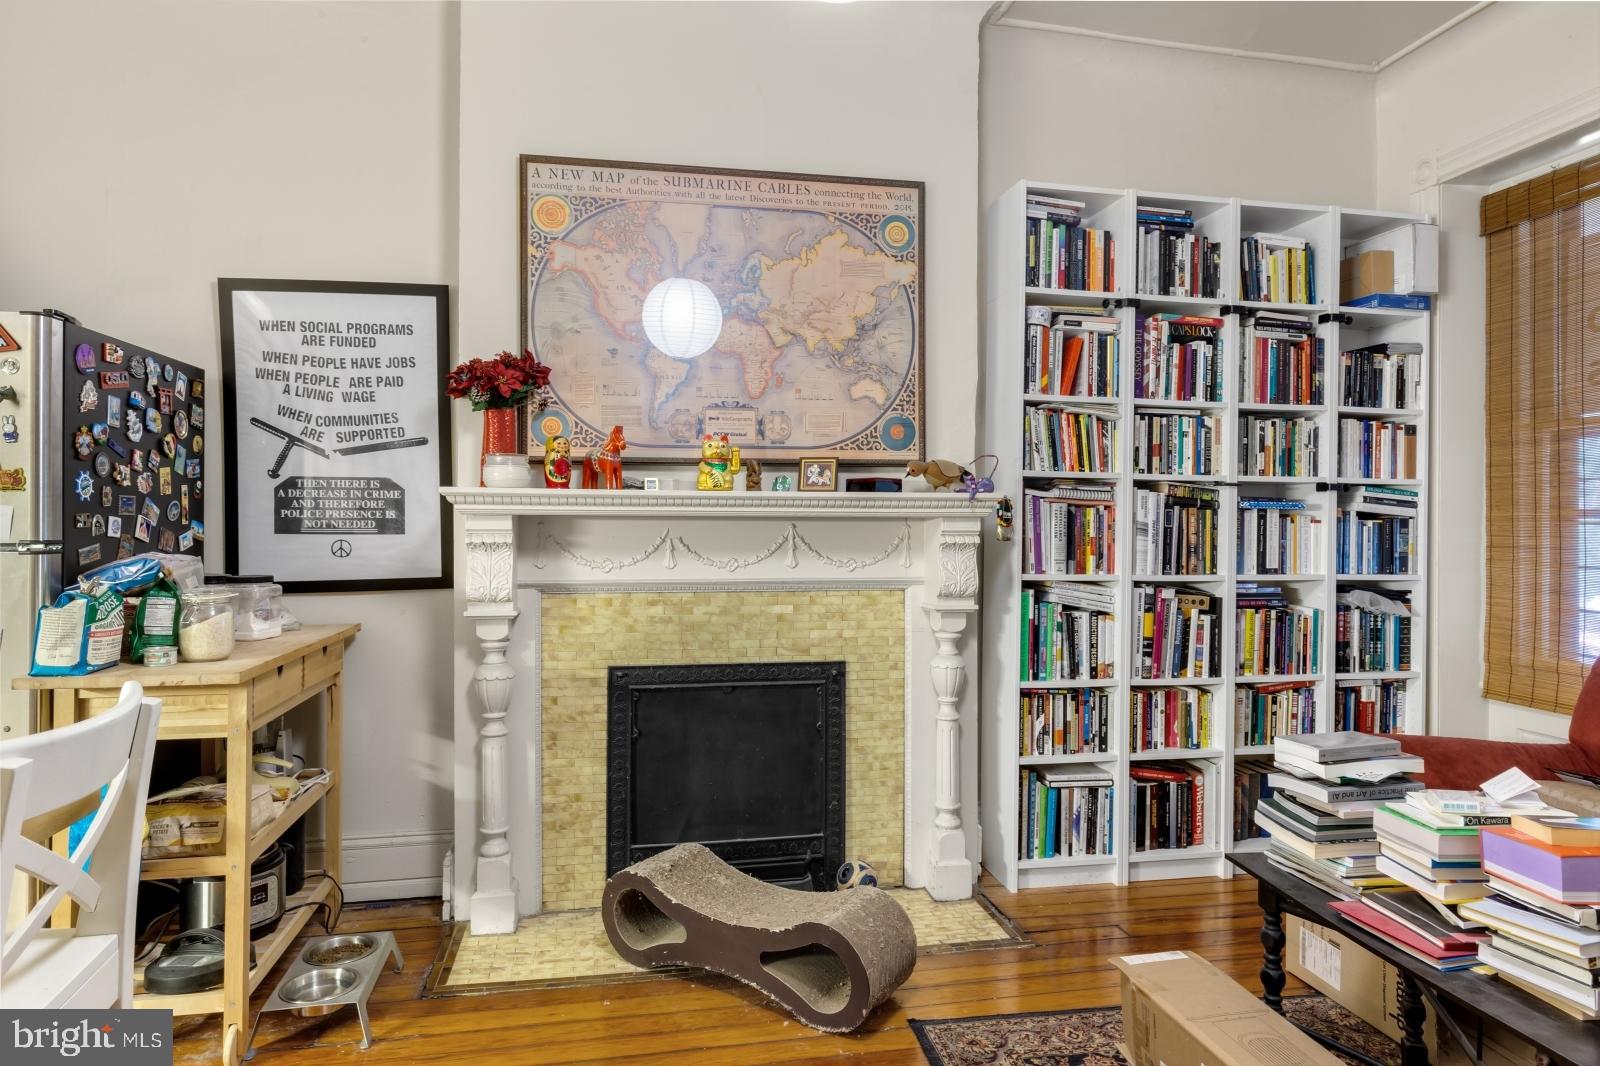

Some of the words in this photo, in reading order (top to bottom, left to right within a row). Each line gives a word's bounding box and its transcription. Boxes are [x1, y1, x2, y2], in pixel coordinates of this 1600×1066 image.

[532, 167, 541, 178] A
[548, 168, 584, 181] NEW
[592, 170, 625, 183] MAP
[630, 175, 643, 186] of
[643, 176, 659, 186] the
[663, 176, 753, 192] SUBMARINE
[758, 181, 811, 196] CABLES
[814, 187, 866, 200] connecting
[867, 189, 882, 200] the
[884, 191, 915, 203] World,
[531, 181, 573, 192] according
[576, 184, 586, 192] to
[589, 184, 602, 193] the
[605, 185, 622, 194] best
[625, 186, 671, 197] Authorities
[674, 189, 693, 199] with
[696, 191, 706, 200] all
[709, 191, 722, 200] the
[725, 193, 746, 202] latest
[750, 194, 793, 205] Discoveries
[796, 197, 804, 205] to
[807, 197, 820, 206] the
[822, 200, 856, 208] PRESENT
[259, 319, 296, 332] WHEN
[300, 321, 343, 334] SOCIAL
[346, 322, 414, 336] PROGRAMS
[1192, 325, 1213, 337] LOCK
[301, 334, 326, 347] ARE
[329, 336, 377, 348] FUNDED
[262, 350, 298, 366] WHEN
[302, 354, 347, 370] PEOPLE
[350, 356, 382, 370] HAVE
[385, 356, 416, 368] JOBS
[255, 367, 291, 383] WHEN
[294, 372, 340, 389] PEOPLE
[349, 376, 373, 389] ARE
[376, 375, 404, 388] PAID
[282, 384, 291, 396] A
[295, 386, 334, 403] LIVING
[342, 390, 376, 403] WAGE
[277, 403, 313, 426] WHEN
[315, 412, 399, 428] COMMUNITIES
[300, 425, 325, 443] ARE
[335, 426, 406, 444] SUPPORTED
[295, 478, 328, 488] THEN
[330, 479, 367, 488] THERE
[370, 479, 380, 488] IS
[277, 488, 286, 498] A
[288, 488, 347, 498] DECREASE
[350, 489, 362, 498] IN
[364, 489, 402, 499] CRIME
[291, 499, 315, 509] AND
[317, 499, 386, 509] THEREFORE
[280, 509, 323, 519] POLICE
[325, 509, 383, 519] PRESENCE
[385, 509, 396, 519] IS
[304, 519, 328, 529] NOT
[330, 519, 376, 529] NEEDED
[1175, 614, 1183, 645] Processing
[1342, 792, 1355, 800] and
[1369, 789, 1376, 797] of
[1377, 787, 1403, 797] Practice
[1466, 816, 1479, 825] On
[1480, 816, 1509, 825] Kawara
